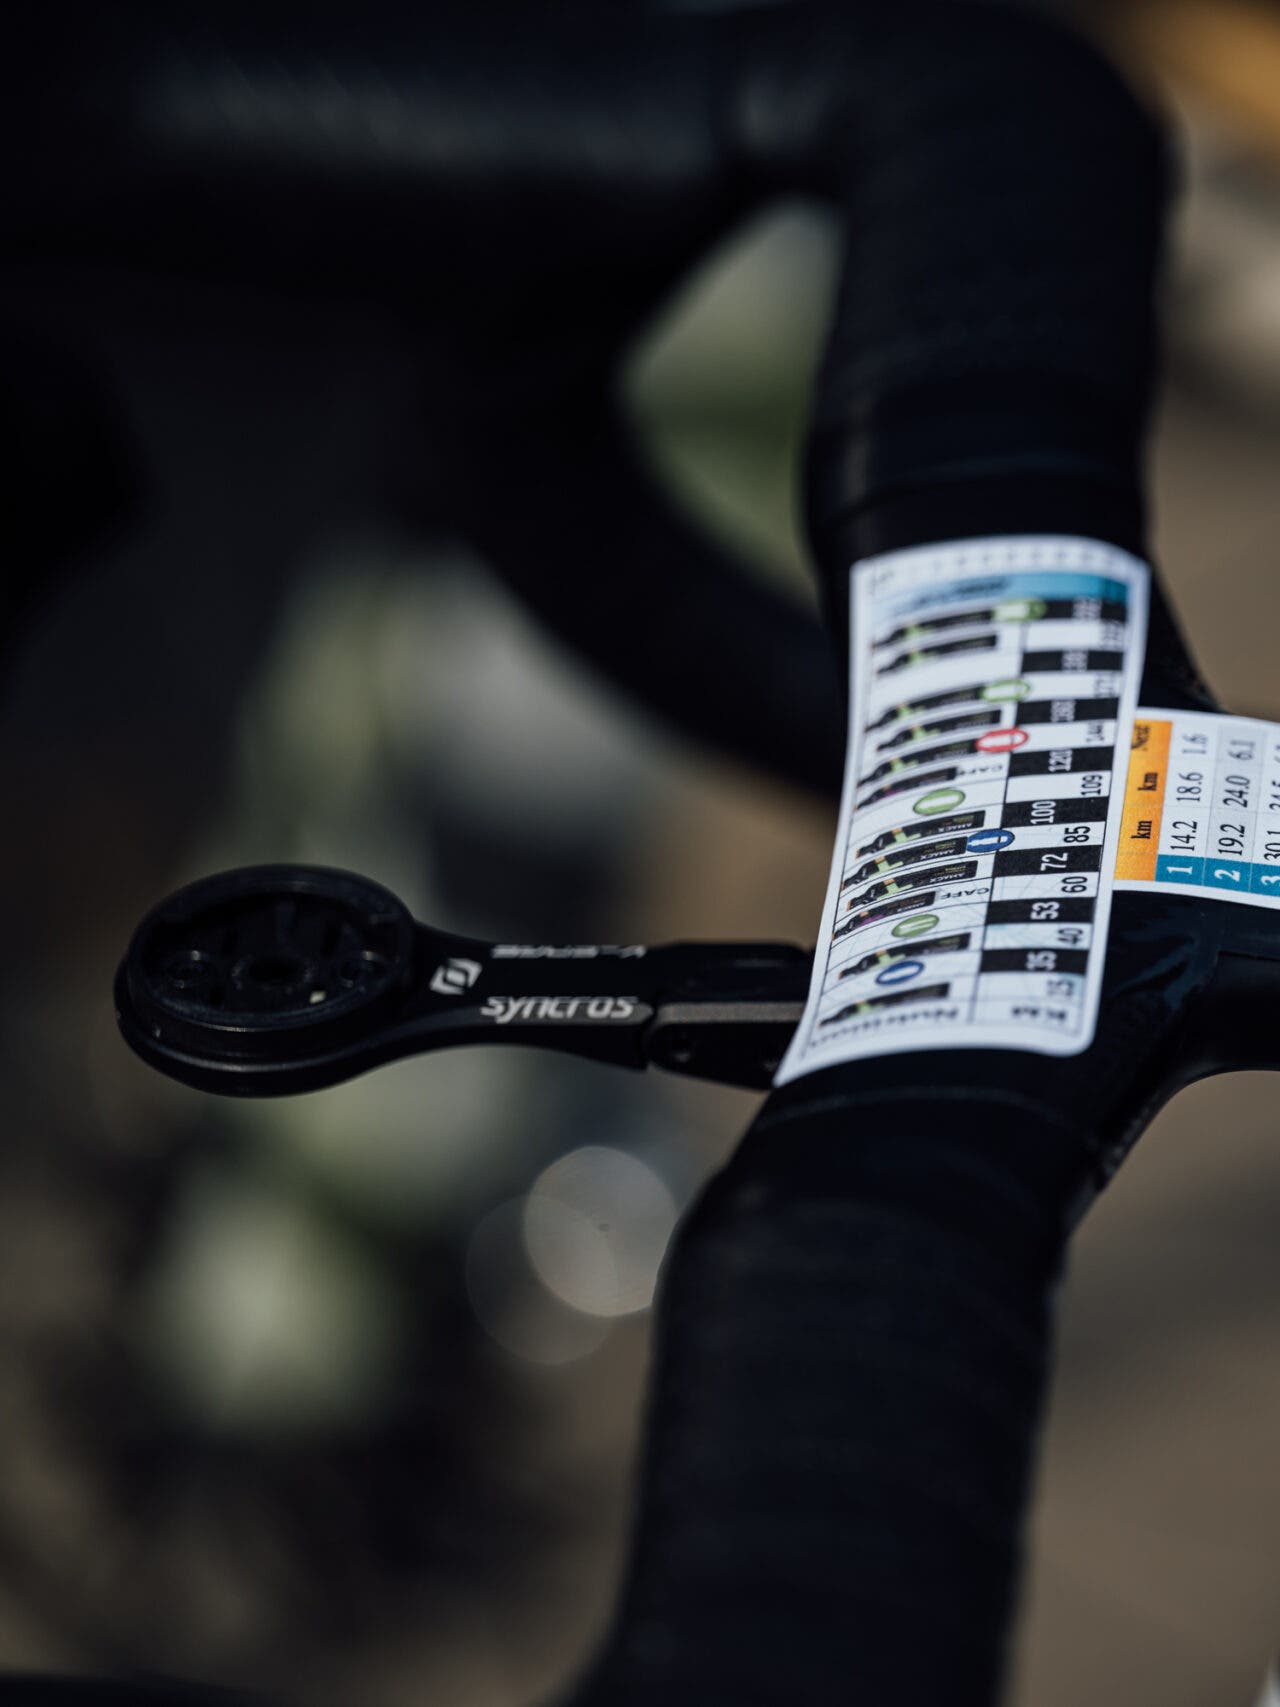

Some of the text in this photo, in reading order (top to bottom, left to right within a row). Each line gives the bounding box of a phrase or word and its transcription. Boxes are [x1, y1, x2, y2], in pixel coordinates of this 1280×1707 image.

[1050, 749, 1072, 772] 120
[1080, 775, 1104, 795] 109
[1137, 772, 1159, 792] km
[1176, 771, 1203, 806] 18.6
[1030, 801, 1056, 825] 100
[1214, 740, 1256, 882] 2 19.2 24.0 6.1
[1064, 826, 1091, 843] 85
[1131, 819, 1153, 840] km
[1171, 819, 1198, 852] 14.2
[1040, 852, 1069, 871] 72
[1166, 865, 1193, 875] 1
[1061, 876, 1088, 893] 60
[1031, 901, 1059, 919] 53
[1058, 929, 1084, 945] 40
[1027, 952, 1056, 971] 35
